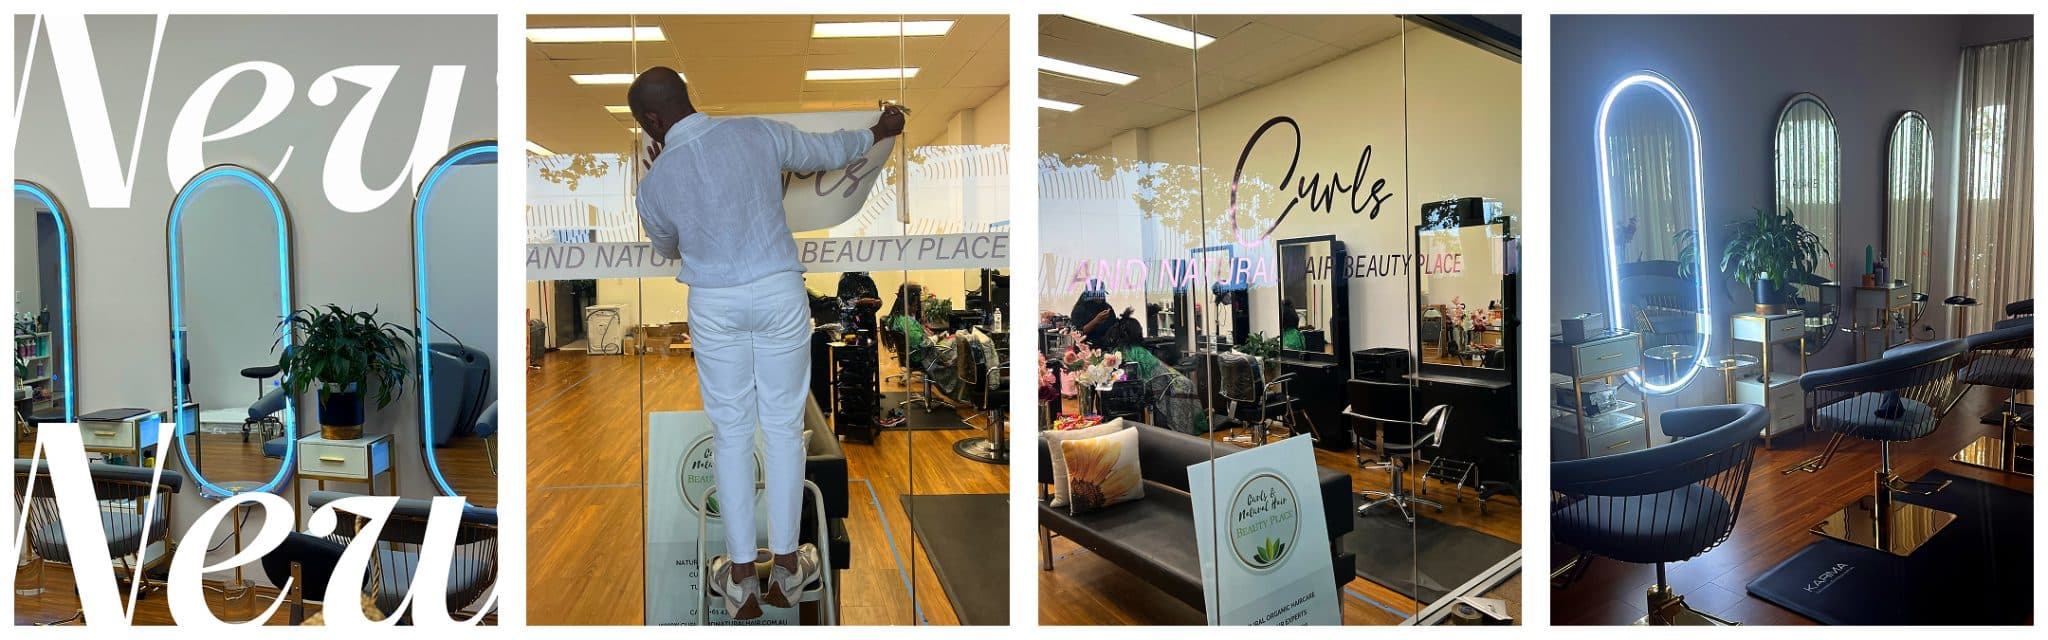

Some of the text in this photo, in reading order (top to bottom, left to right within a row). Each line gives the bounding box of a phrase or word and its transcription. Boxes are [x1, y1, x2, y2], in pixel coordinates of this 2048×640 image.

[1230, 116, 1393, 248] Curls
[526, 246, 585, 269] AND
[801, 238, 912, 263] BEAUTY
[918, 235, 1009, 261] PLACE
[1067, 253, 1461, 292] AND NATURAL AIR BEAUTY PLACE
[1247, 489, 1267, 506] Curls
[1802, 563, 1848, 592] KARMA
[1266, 604, 1291, 621] ORGANIC
